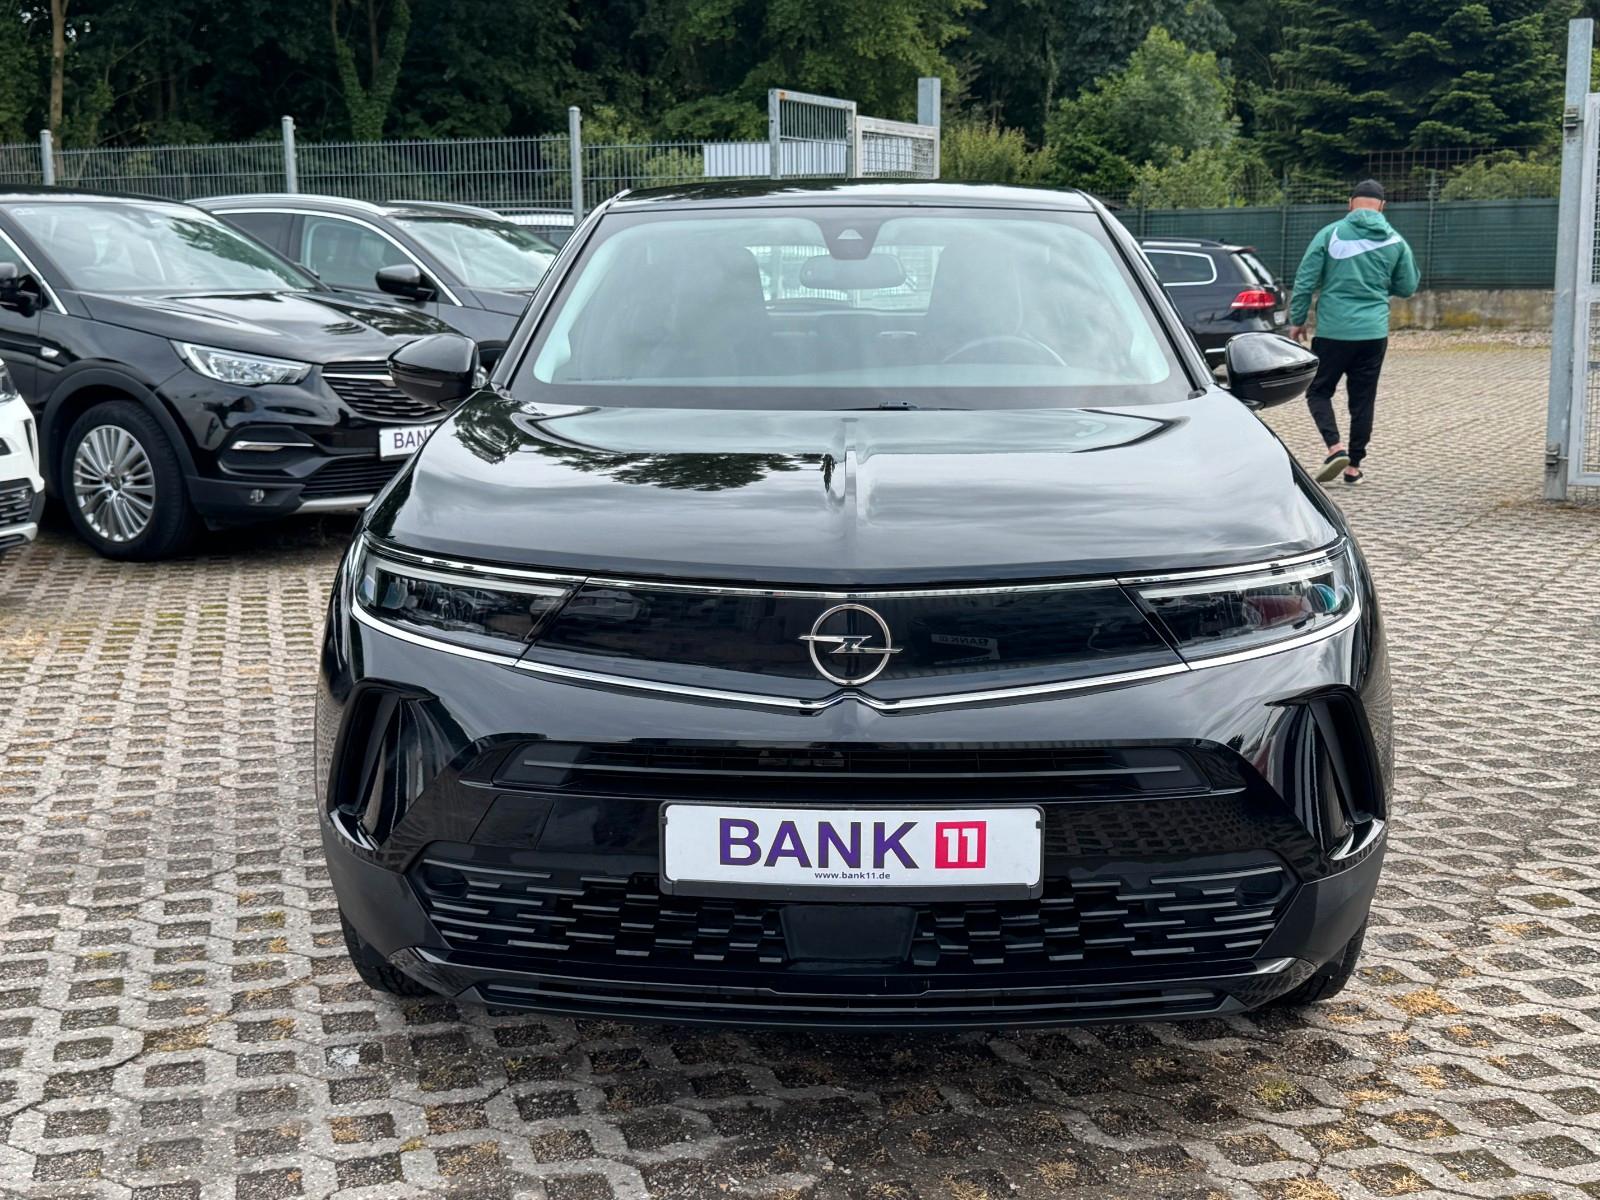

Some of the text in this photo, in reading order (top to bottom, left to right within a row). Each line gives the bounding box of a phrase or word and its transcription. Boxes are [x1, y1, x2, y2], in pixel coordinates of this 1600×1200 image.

[394, 429, 432, 449] BAN
[719, 817, 979, 869] BANK 11
[814, 871, 891, 880] www.bank11.de
